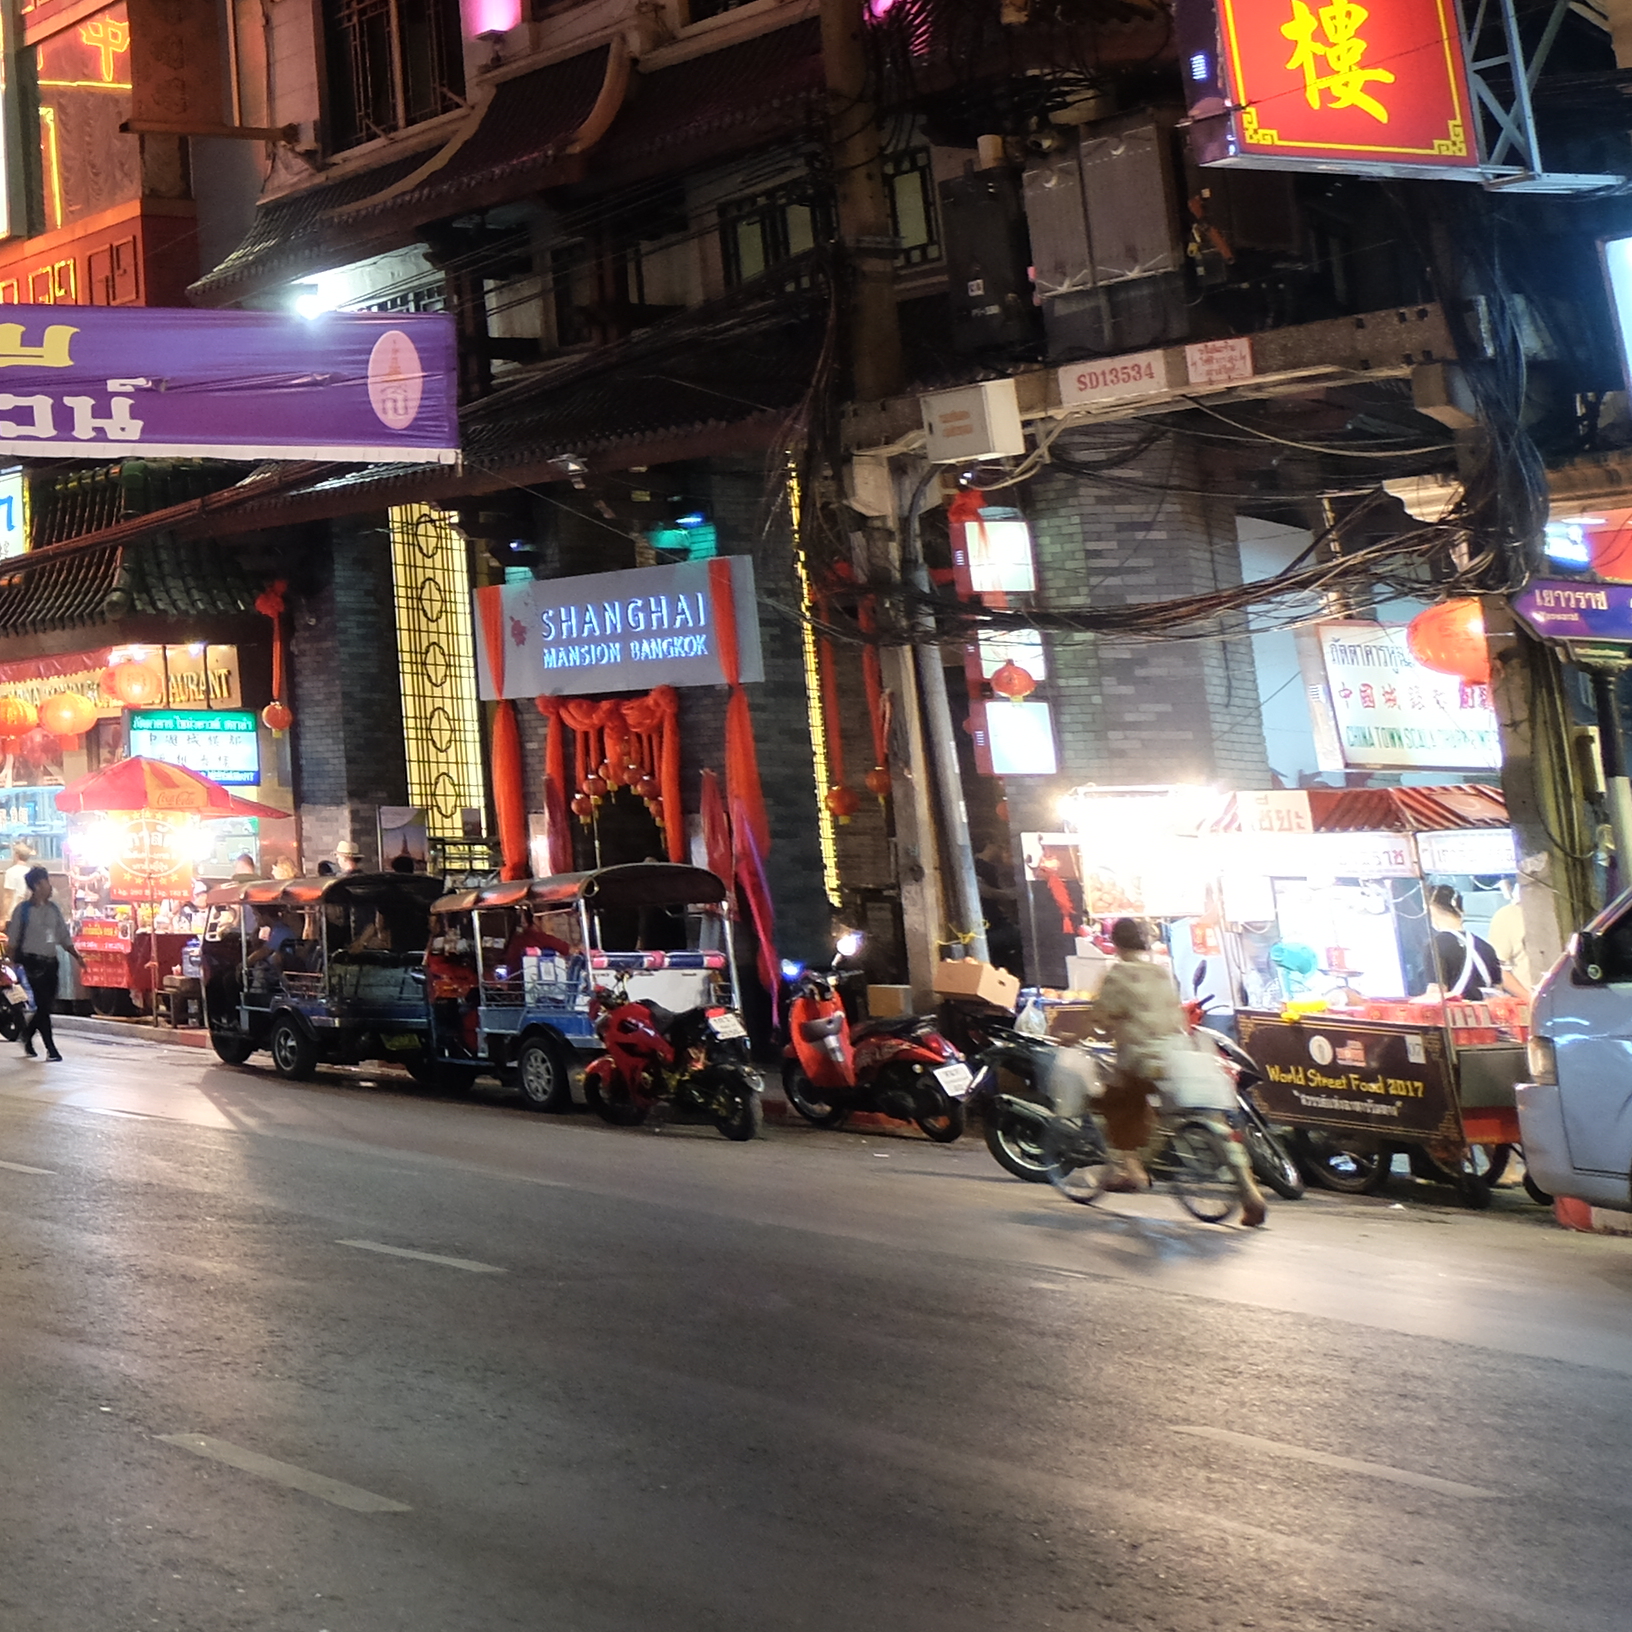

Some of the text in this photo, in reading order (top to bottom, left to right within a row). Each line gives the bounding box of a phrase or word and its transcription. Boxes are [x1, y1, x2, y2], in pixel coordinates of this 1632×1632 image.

[540, 590, 708, 642] SHANGHAI
[1534, 588, 1609, 611] เยาวราช
[543, 634, 709, 669] MANSION BANGKOK
[1265, 1064, 1425, 1099] World Street Food 2017
